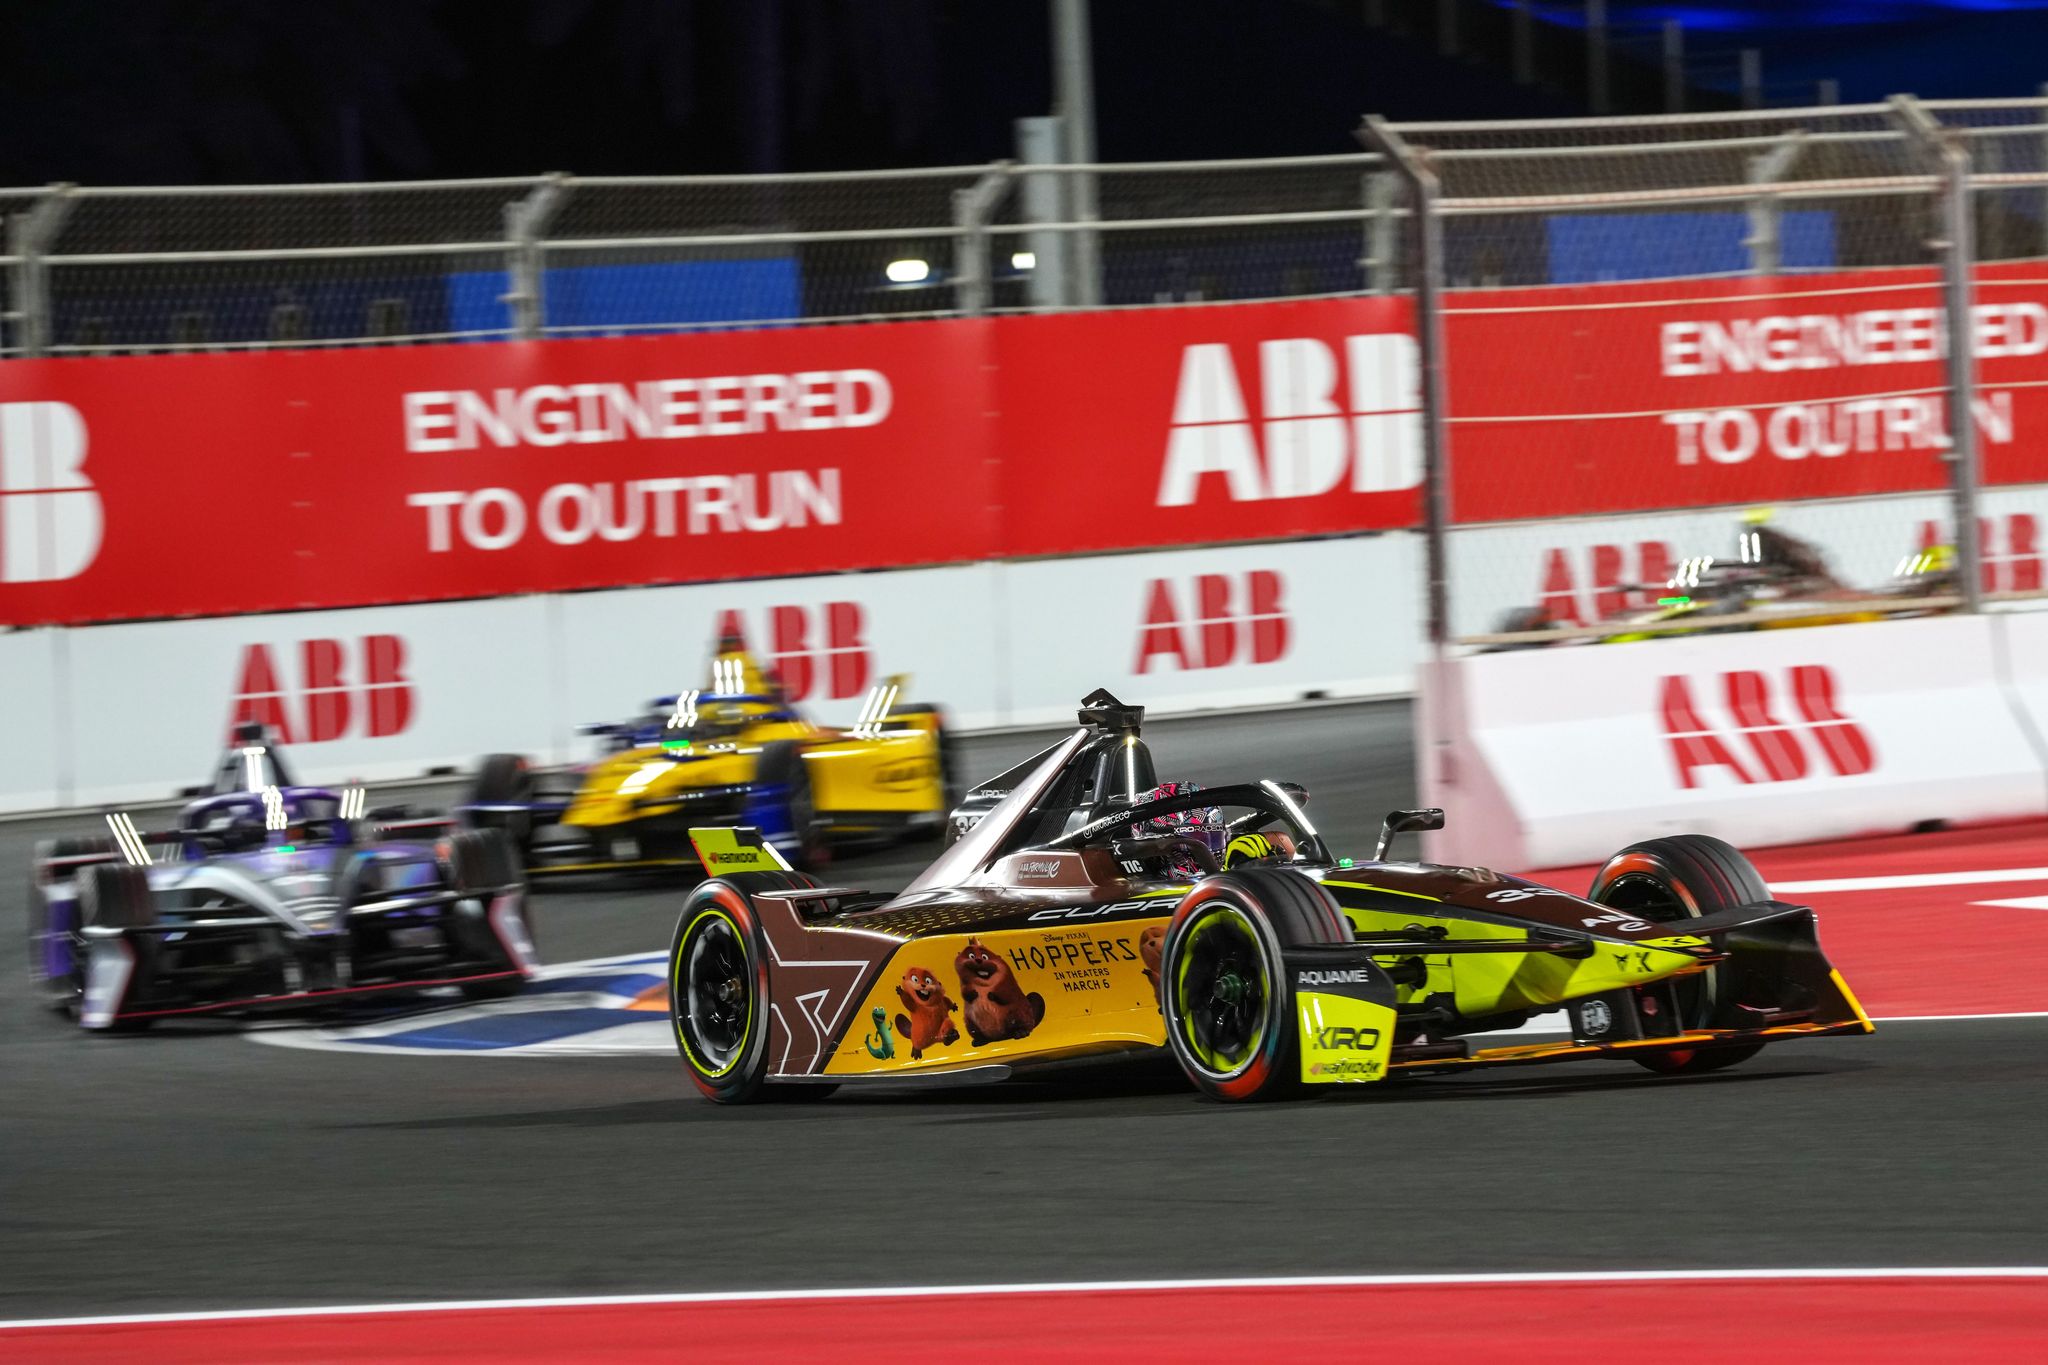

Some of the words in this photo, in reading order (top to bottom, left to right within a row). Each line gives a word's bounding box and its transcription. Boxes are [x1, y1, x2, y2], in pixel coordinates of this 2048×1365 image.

[1661, 302, 2048, 376] ENGINEEED
[404, 368, 893, 452] ENGINEERED
[1156, 333, 1427, 507] ABB
[1661, 409, 1760, 465] TO
[406, 487, 527, 552] TO
[537, 468, 842, 545] OUTRUN
[1133, 570, 1292, 675] ABB
[228, 633, 418, 747] ABB
[1657, 664, 1877, 789] ABB
[1120, 860, 1144, 874] TIC
[1027, 897, 1184, 921] CUPR
[1009, 938, 1138, 971] HOPPERS
[1054, 971, 1065, 981] IN
[1067, 967, 1110, 979] THEATERS
[1063, 980, 1101, 992] MARCH
[1103, 978, 1110, 989] 6
